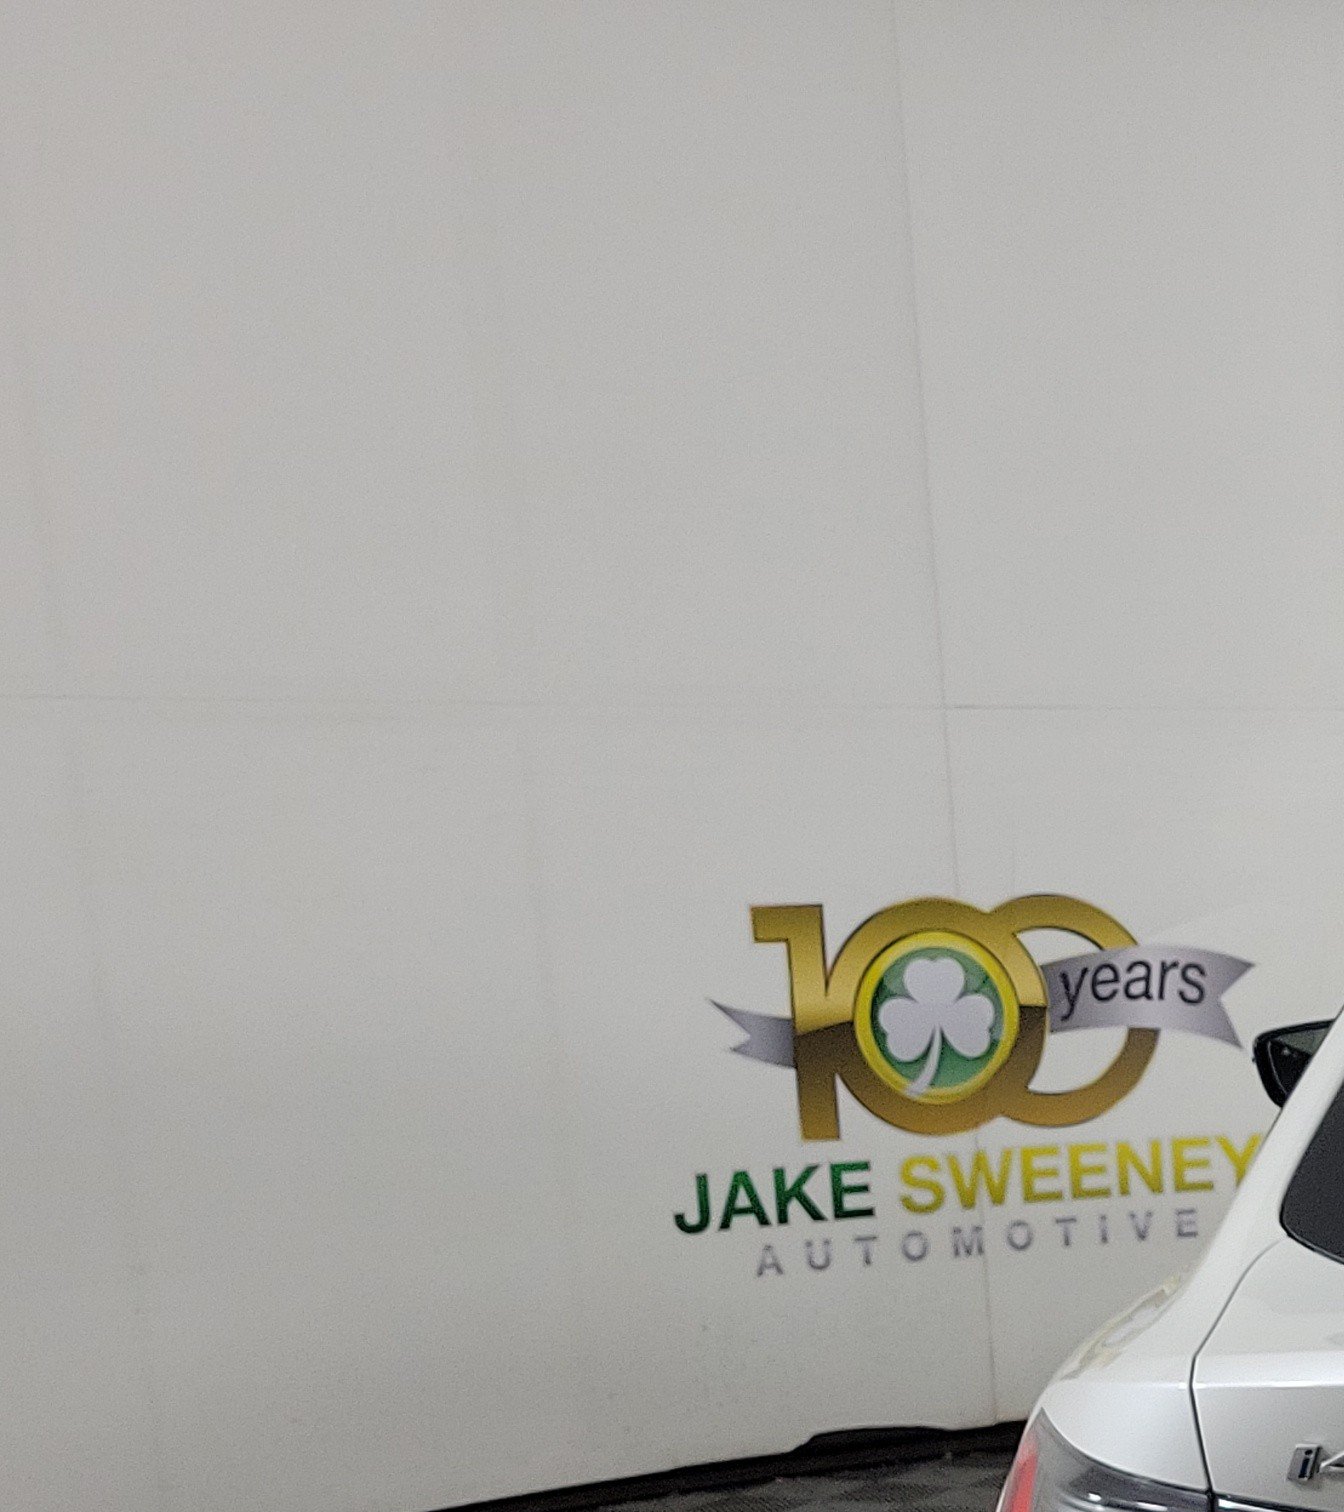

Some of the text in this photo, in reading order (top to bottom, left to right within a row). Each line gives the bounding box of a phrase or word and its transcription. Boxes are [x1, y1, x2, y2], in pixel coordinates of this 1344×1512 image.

[750, 893, 1160, 1142] 100
[1058, 959, 1207, 1020] years
[674, 1133, 1262, 1235] JAKE SWEENEY
[755, 1207, 1200, 1278] AUTOMOTIVE
